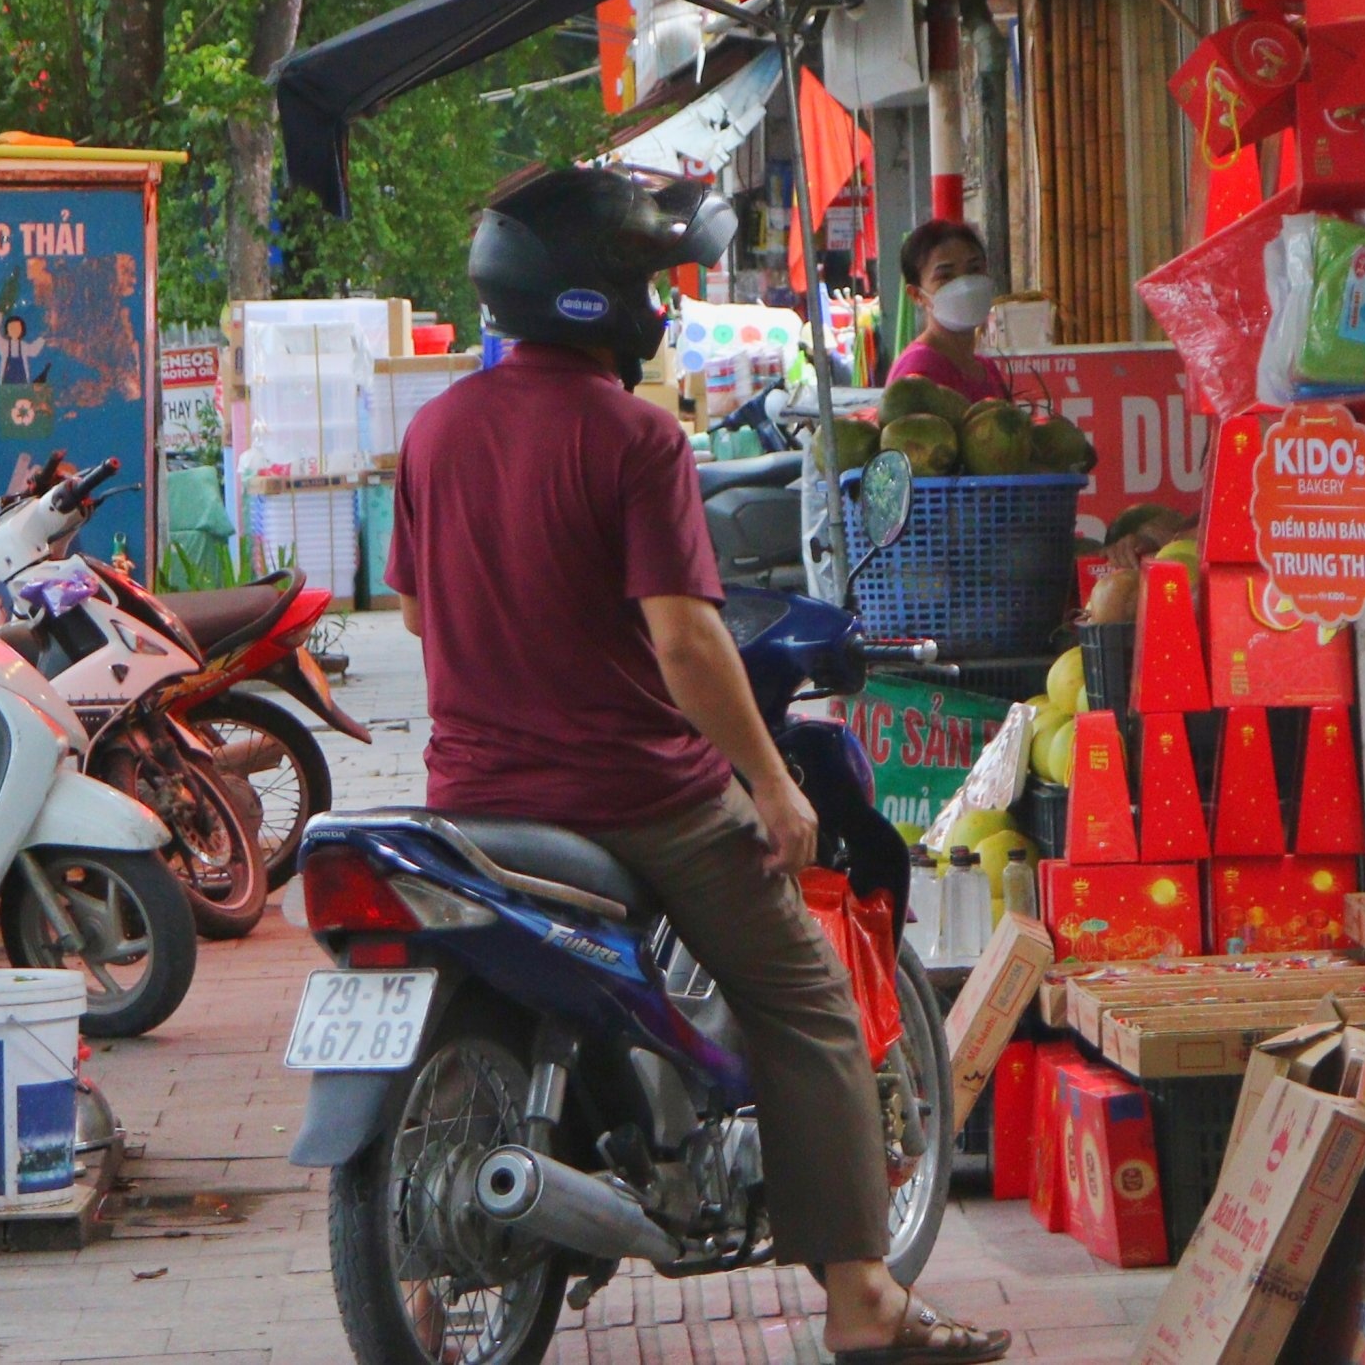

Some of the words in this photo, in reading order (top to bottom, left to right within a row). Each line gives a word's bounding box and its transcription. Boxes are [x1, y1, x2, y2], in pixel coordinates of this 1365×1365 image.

[19, 209, 85, 256] THẢI
[161, 352, 213, 369] ENEOS
[1274, 438, 1365, 476] KIDO's
[1298, 479, 1345, 494] BAKERY
[1271, 515, 1305, 539] ĐIỂM
[1308, 518, 1336, 539] BÁN
[1272, 552, 1336, 577] TRUNG
[902, 692, 973, 769] SẢN
[308, 831, 346, 839] HONDA
[318, 977, 415, 1016] 29-Y5
